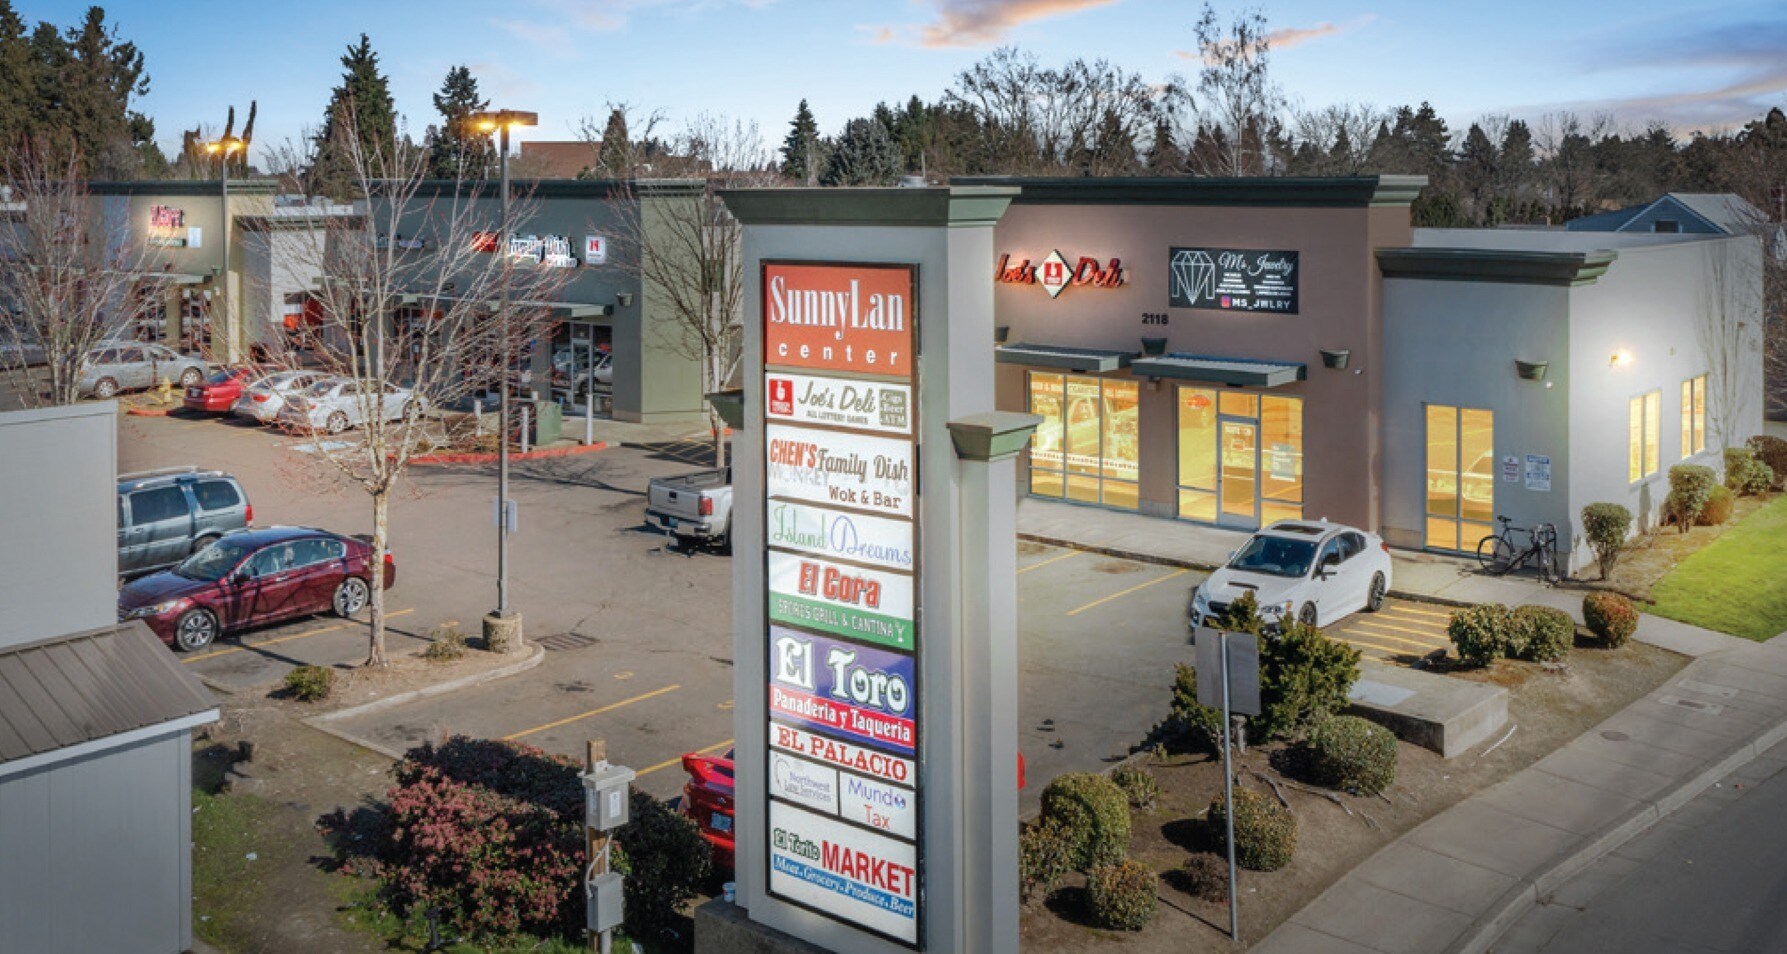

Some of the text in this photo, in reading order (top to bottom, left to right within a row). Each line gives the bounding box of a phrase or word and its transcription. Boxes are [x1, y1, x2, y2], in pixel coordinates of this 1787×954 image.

[1072, 256, 1125, 288] Deli
[770, 275, 904, 340] SunnyLan
[1141, 313, 1169, 325] 2118
[778, 342, 898, 366] center
[797, 380, 835, 410] Joe's
[839, 385, 876, 414] Deli
[770, 438, 909, 483] CHEN'S Family Dish
[828, 485, 902, 509] Wok & Bar
[774, 504, 912, 565] Island Dreams
[798, 562, 882, 610] El Cora
[777, 599, 894, 639] SPORTS GRILL & CANTINA
[775, 636, 909, 714] El Toro
[773, 688, 911, 743] Panaderia y Taqueria
[777, 726, 909, 782] EL PALACIO
[863, 803, 891, 830] Tax
[821, 839, 915, 898] MARKET
